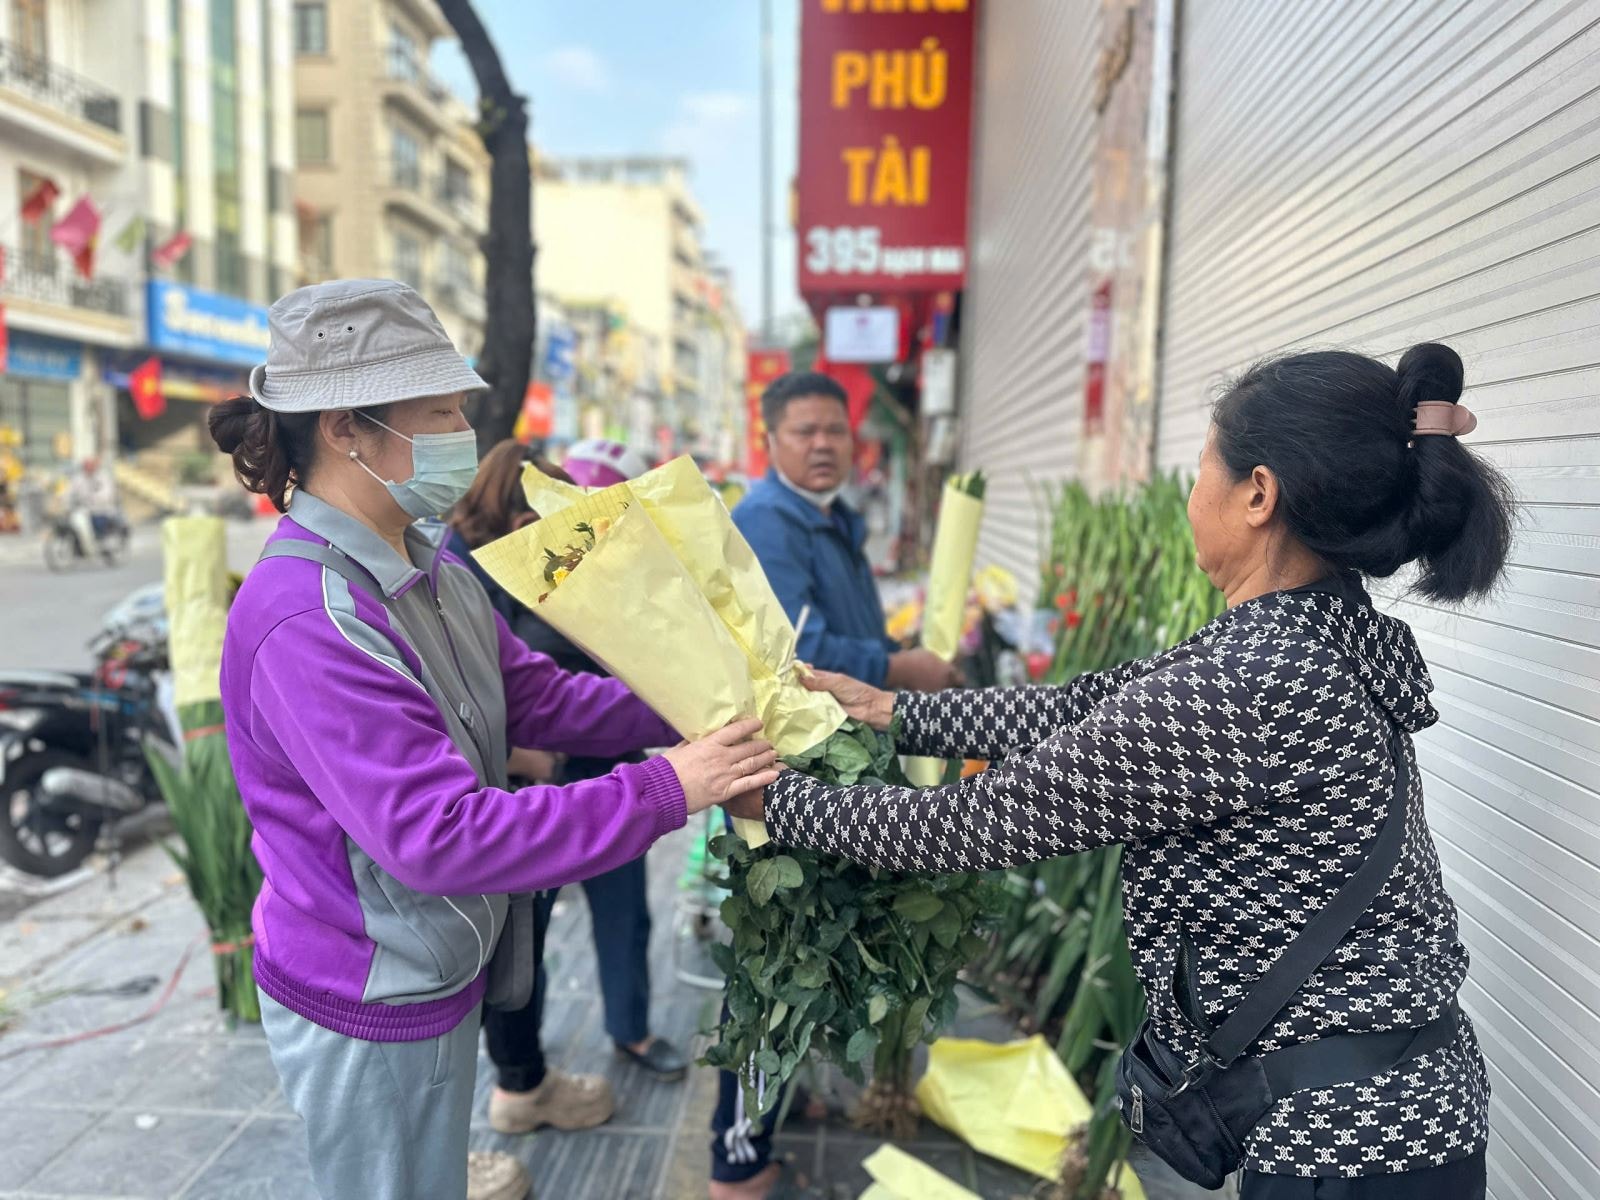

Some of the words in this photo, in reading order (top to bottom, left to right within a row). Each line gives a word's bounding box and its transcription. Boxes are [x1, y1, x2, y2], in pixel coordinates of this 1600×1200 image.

[833, 37, 947, 109] PHÚ
[842, 135, 931, 205] TÀI
[805, 226, 881, 274] 395
